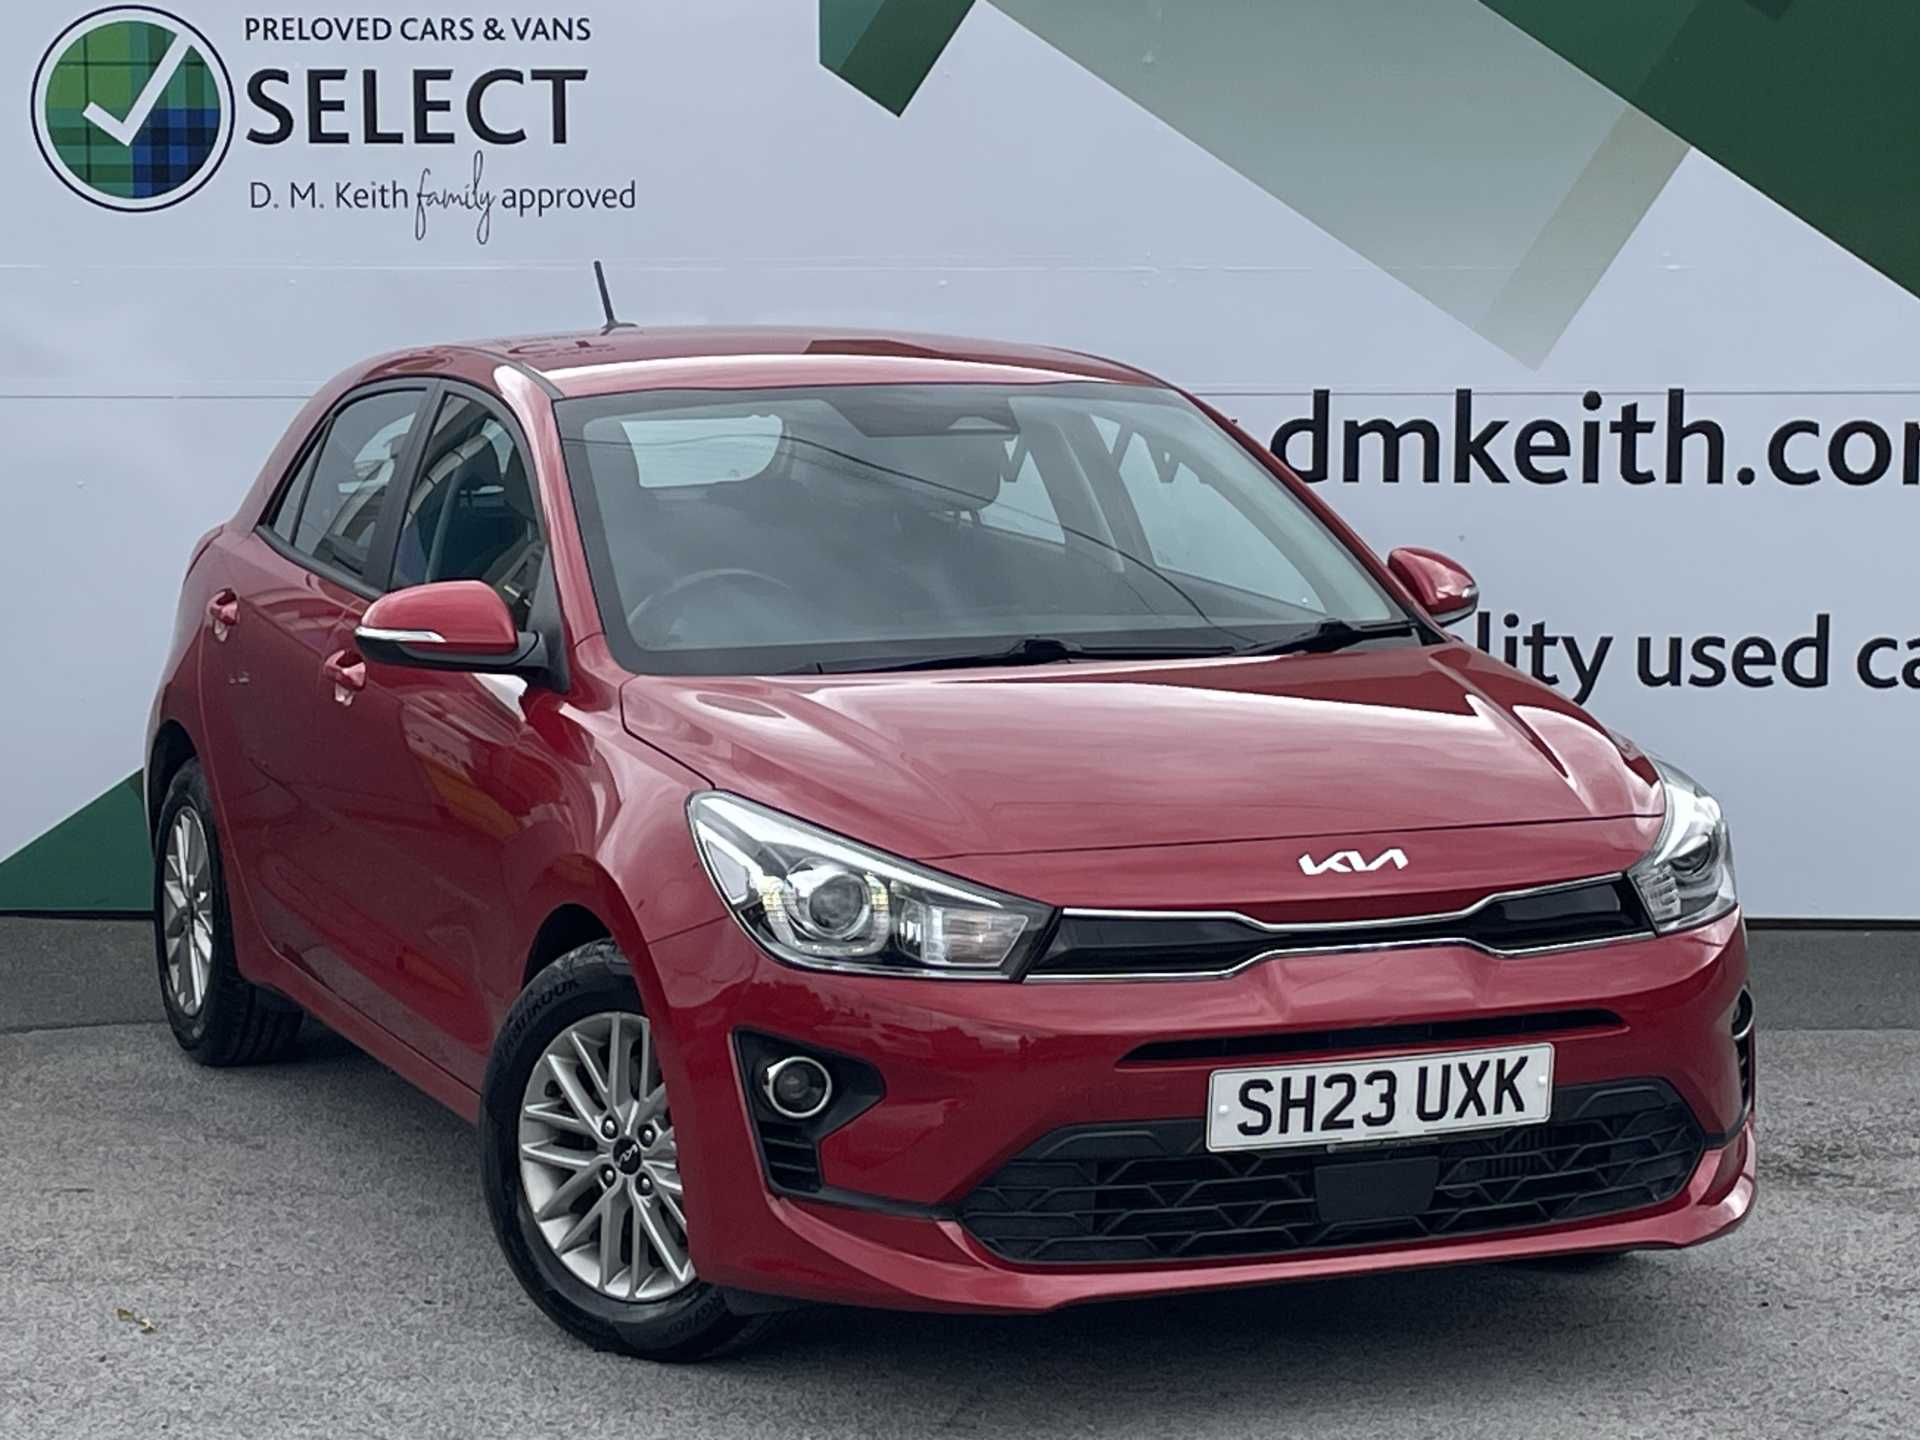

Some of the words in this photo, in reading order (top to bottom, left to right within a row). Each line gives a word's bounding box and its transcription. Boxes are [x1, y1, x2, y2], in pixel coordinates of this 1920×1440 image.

[245, 17, 392, 41] PRELOVED
[399, 17, 475, 41] CARS
[482, 17, 506, 41] &
[511, 17, 591, 41] VANS
[246, 68, 589, 146] SELECT
[250, 181, 279, 209] D.
[290, 181, 325, 209] M.
[335, 180, 409, 209] Keith
[415, 150, 496, 244] family
[501, 179, 636, 217] approved
[1477, 611, 1613, 705] lity
[1637, 614, 1830, 689] used
[1299, 848, 1409, 876] KIA
[1236, 1069, 1399, 1138] SH23
[1415, 1055, 1530, 1124] UXK
